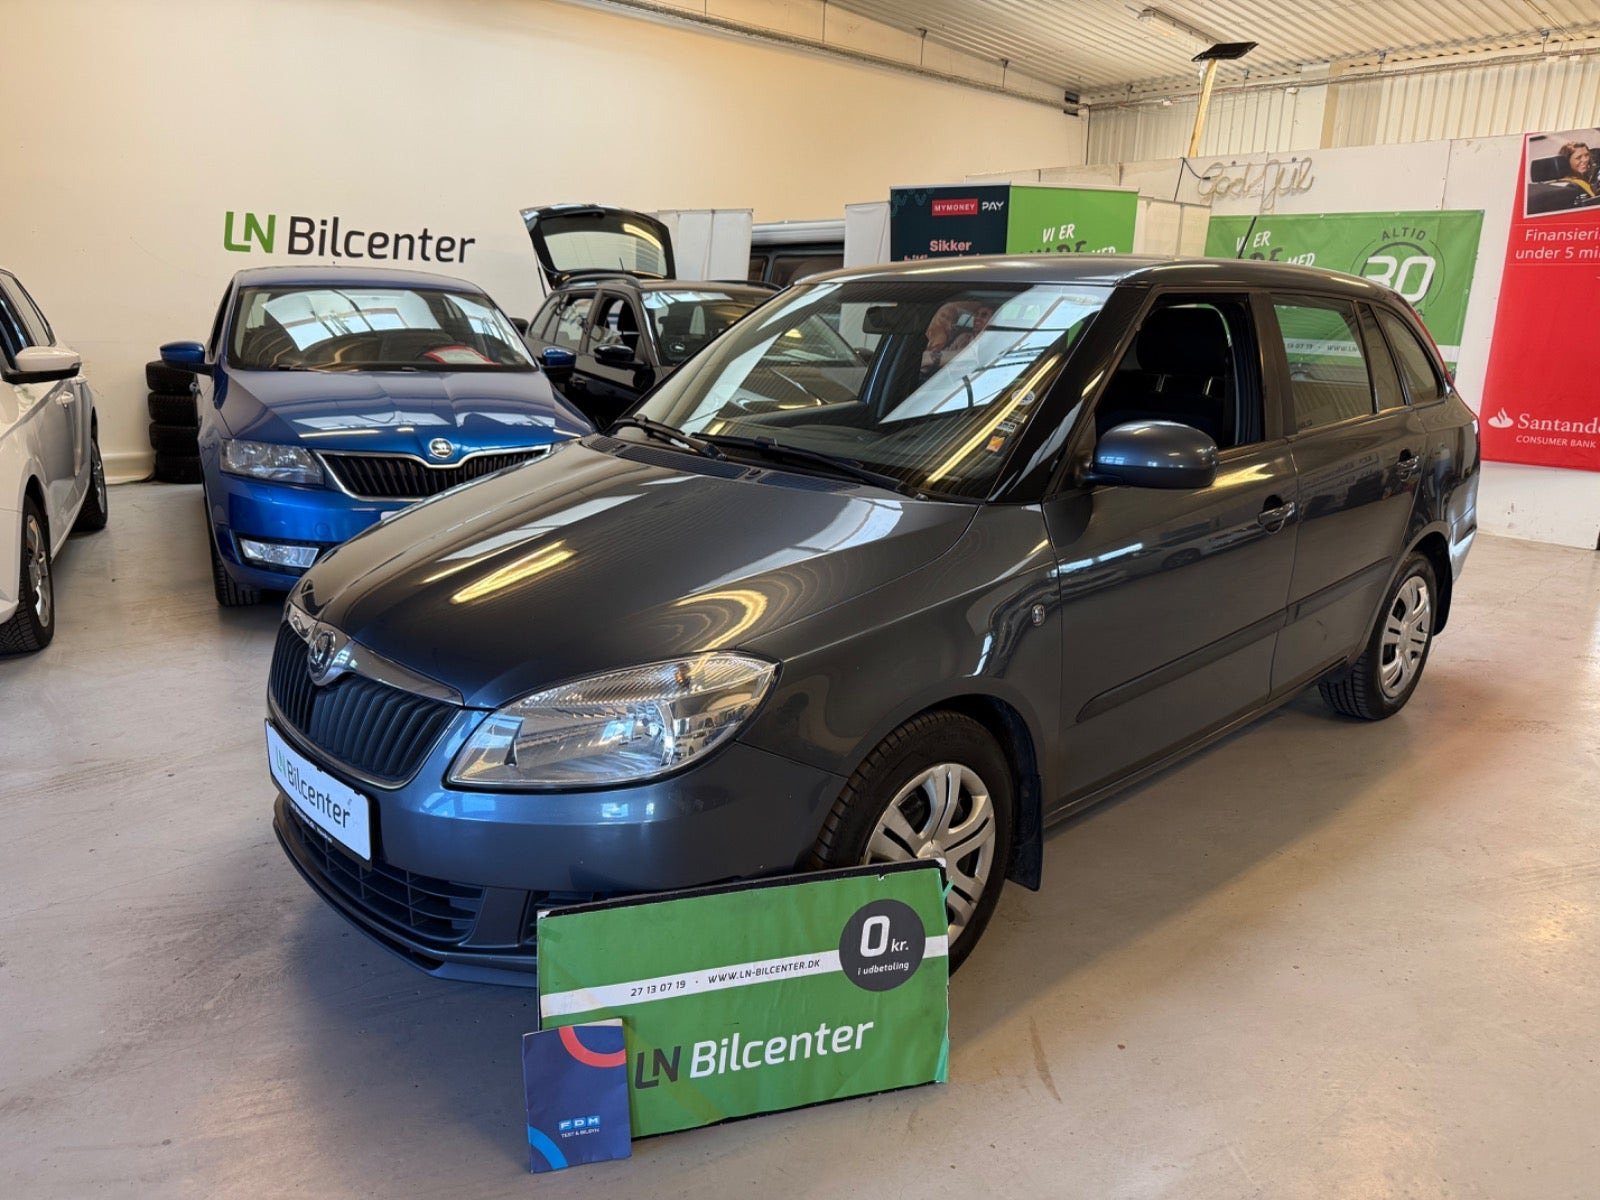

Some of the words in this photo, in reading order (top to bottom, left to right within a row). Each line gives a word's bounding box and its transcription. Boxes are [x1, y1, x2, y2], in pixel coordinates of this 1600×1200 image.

[933, 203, 976, 212] MYMONEY
[981, 201, 1004, 211] PAY
[223, 211, 276, 254] LN
[287, 216, 475, 263] Bilcenter
[1042, 227, 1055, 244] VI
[1058, 223, 1076, 241] ER
[1253, 230, 1271, 248] ER
[1382, 227, 1426, 241] ALTID
[1525, 227, 1600, 242] Finansieri
[929, 239, 972, 252] Sikker
[1515, 246, 1560, 259] under
[1564, 246, 1575, 259] 5
[1578, 245, 1600, 259] mi
[1366, 255, 1436, 302] 30
[1517, 413, 1600, 434] Santand
[1516, 435, 1567, 446] CONSUMER
[1570, 438, 1597, 448] BANK
[286, 759, 351, 829] Bilcenter
[860, 915, 891, 957] 0
[891, 938, 909, 953] kr.
[863, 961, 910, 975] udbetaling
[630, 988, 643, 997] 27
[647, 985, 656, 994] 13
[660, 983, 673, 992] 07
[676, 980, 686, 989] 19
[708, 959, 820, 984] WWW.LN-BILCENTER.DK
[634, 1046, 681, 1090] LN
[690, 1021, 874, 1079] Bilcenter
